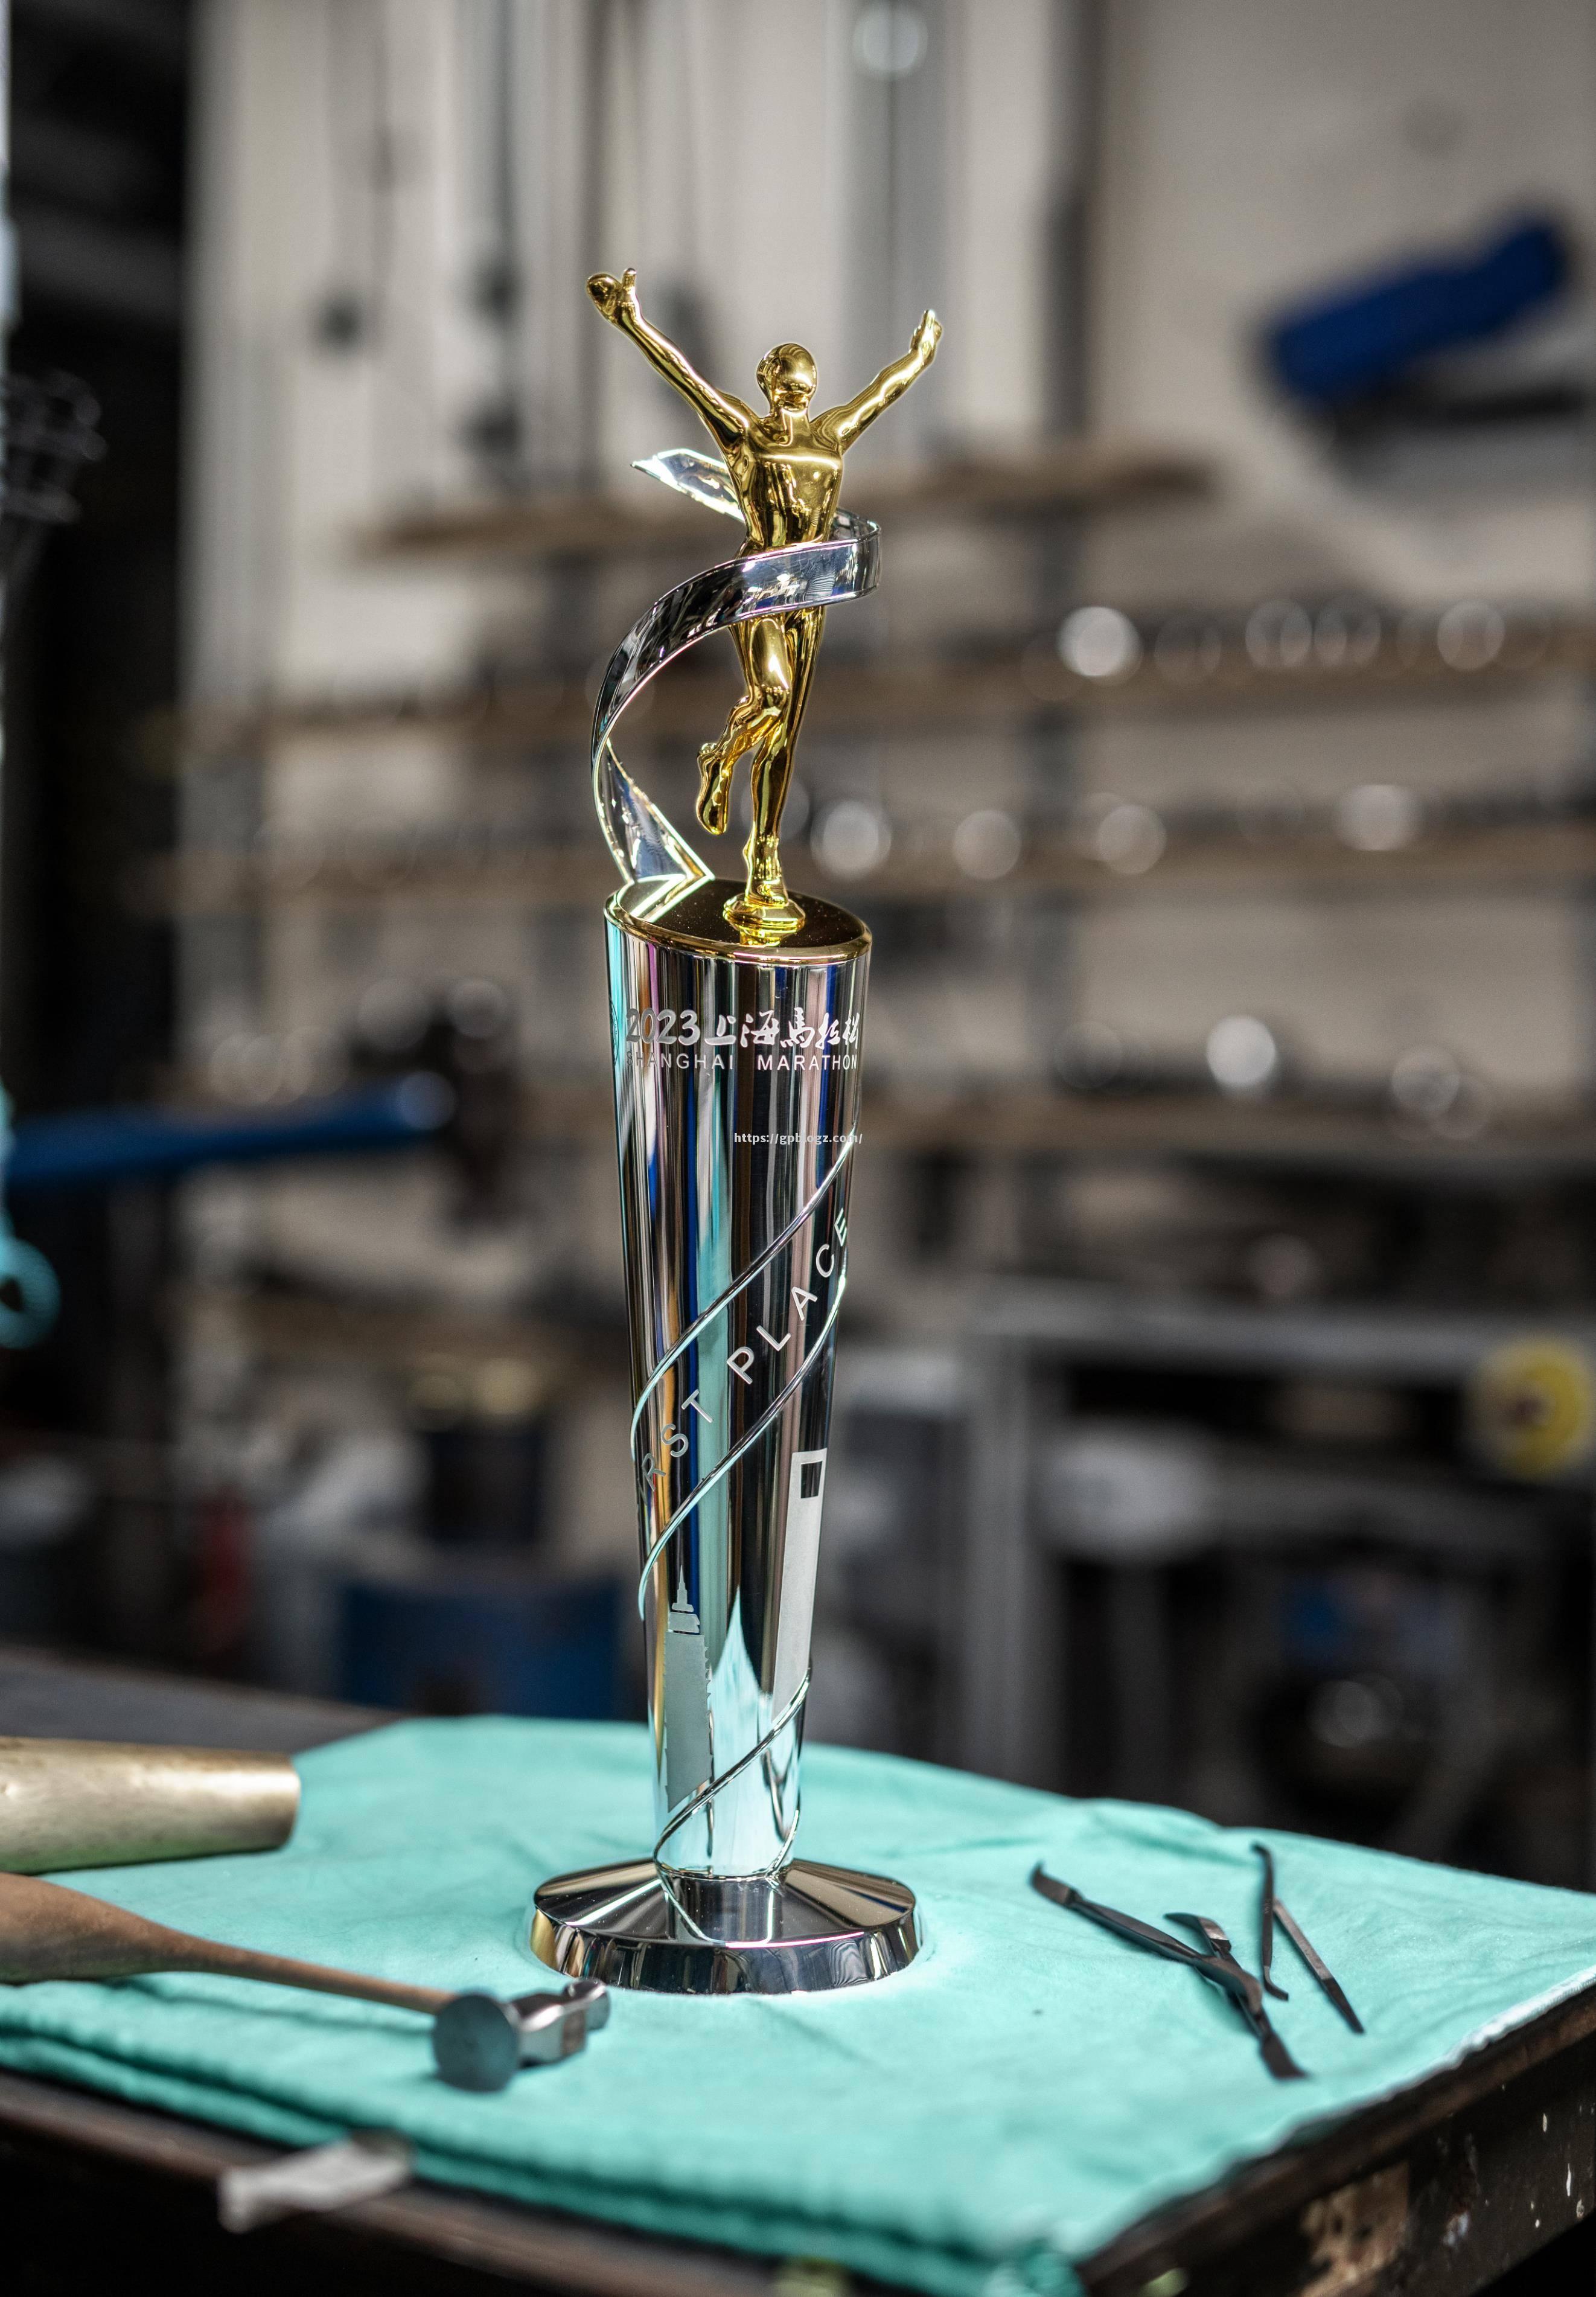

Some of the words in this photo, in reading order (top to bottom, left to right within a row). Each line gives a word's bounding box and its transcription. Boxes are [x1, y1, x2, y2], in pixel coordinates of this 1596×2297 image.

[626, 1050, 734, 1070] SHANGHAI
[758, 1054, 857, 1070] MARATHON
[726, 1208, 847, 1384] PLACE
